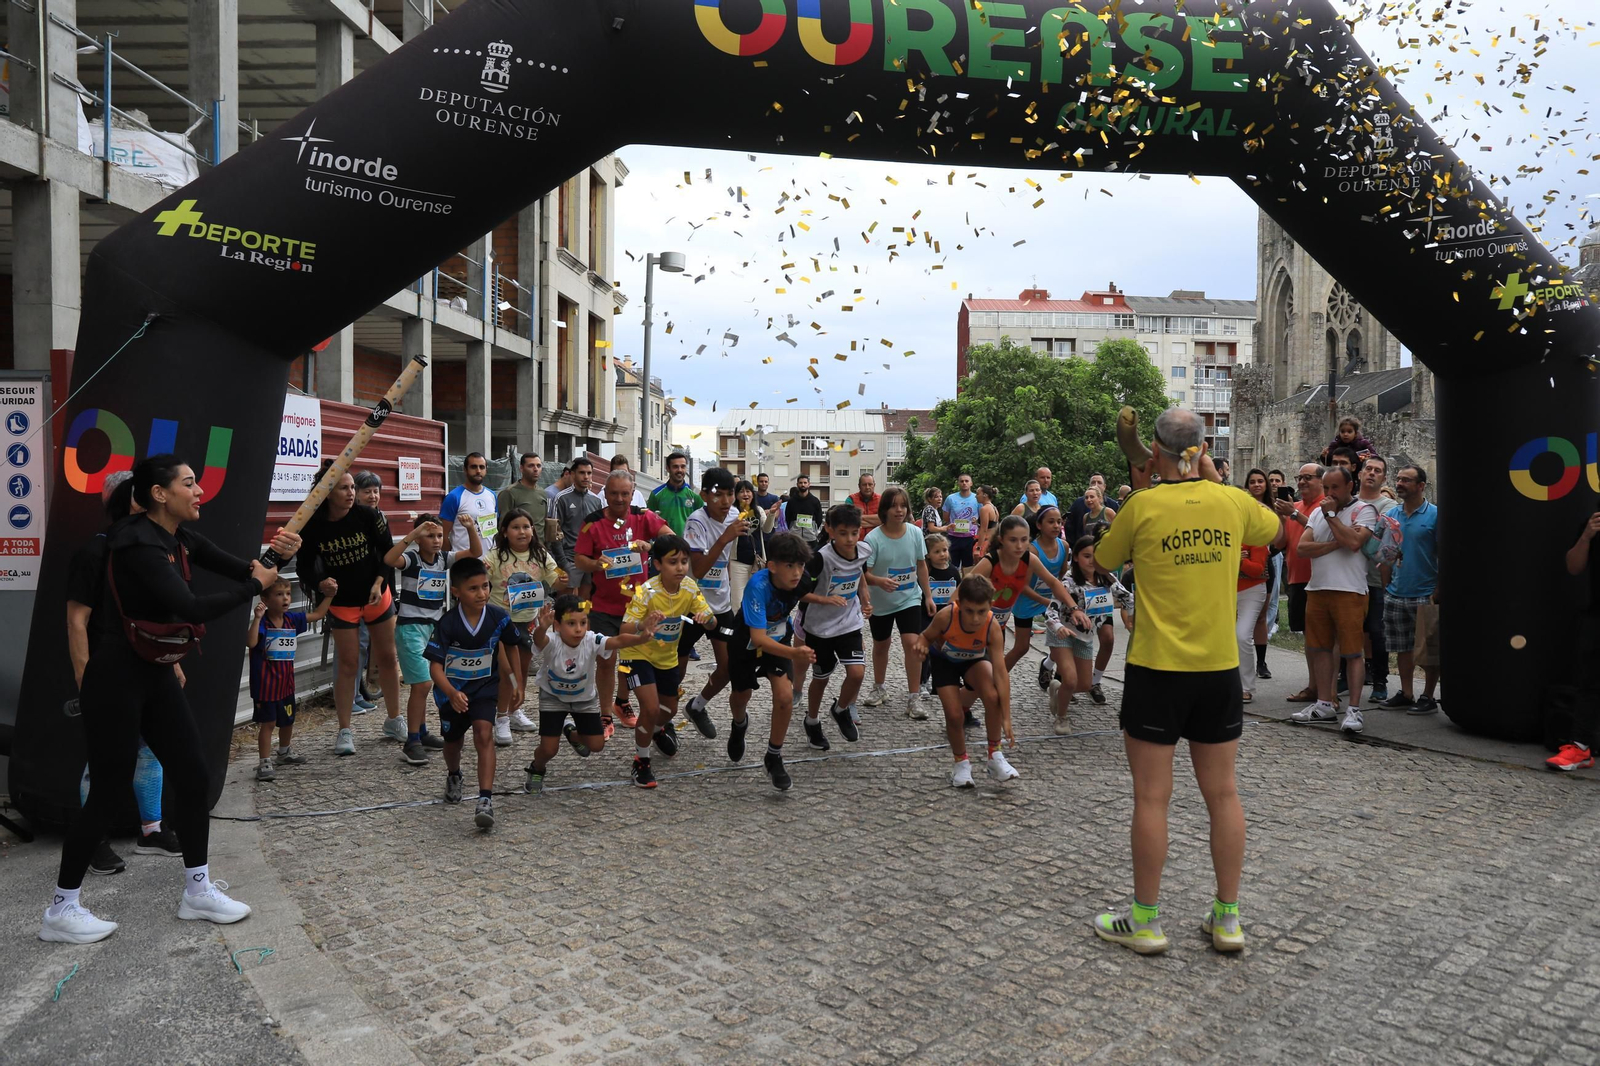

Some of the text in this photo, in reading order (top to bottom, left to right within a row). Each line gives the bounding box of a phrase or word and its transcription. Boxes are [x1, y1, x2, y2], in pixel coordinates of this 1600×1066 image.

[419, 87, 561, 127] DEPUTACIÓN
[435, 109, 538, 141] OURENSE
[309, 146, 398, 181] inorde
[1338, 176, 1420, 193] OURENSE
[305, 176, 452, 215] turismo Ourense
[1438, 219, 1495, 240] norde
[1435, 241, 1529, 261] turismo Ournse
[220, 245, 313, 273] La Región
[1161, 528, 1231, 553] KÓRPORE
[615, 555, 632, 565] 331
[708, 568, 721, 577] 320
[897, 574, 911, 582] 324
[430, 579, 446, 588] 337
[840, 581, 856, 591] 328
[521, 590, 537, 600] 336
[937, 587, 950, 595] 316
[1095, 595, 1108, 604] 325
[663, 622, 681, 632] 322
[278, 638, 295, 647] 335
[460, 658, 482, 667] 326
